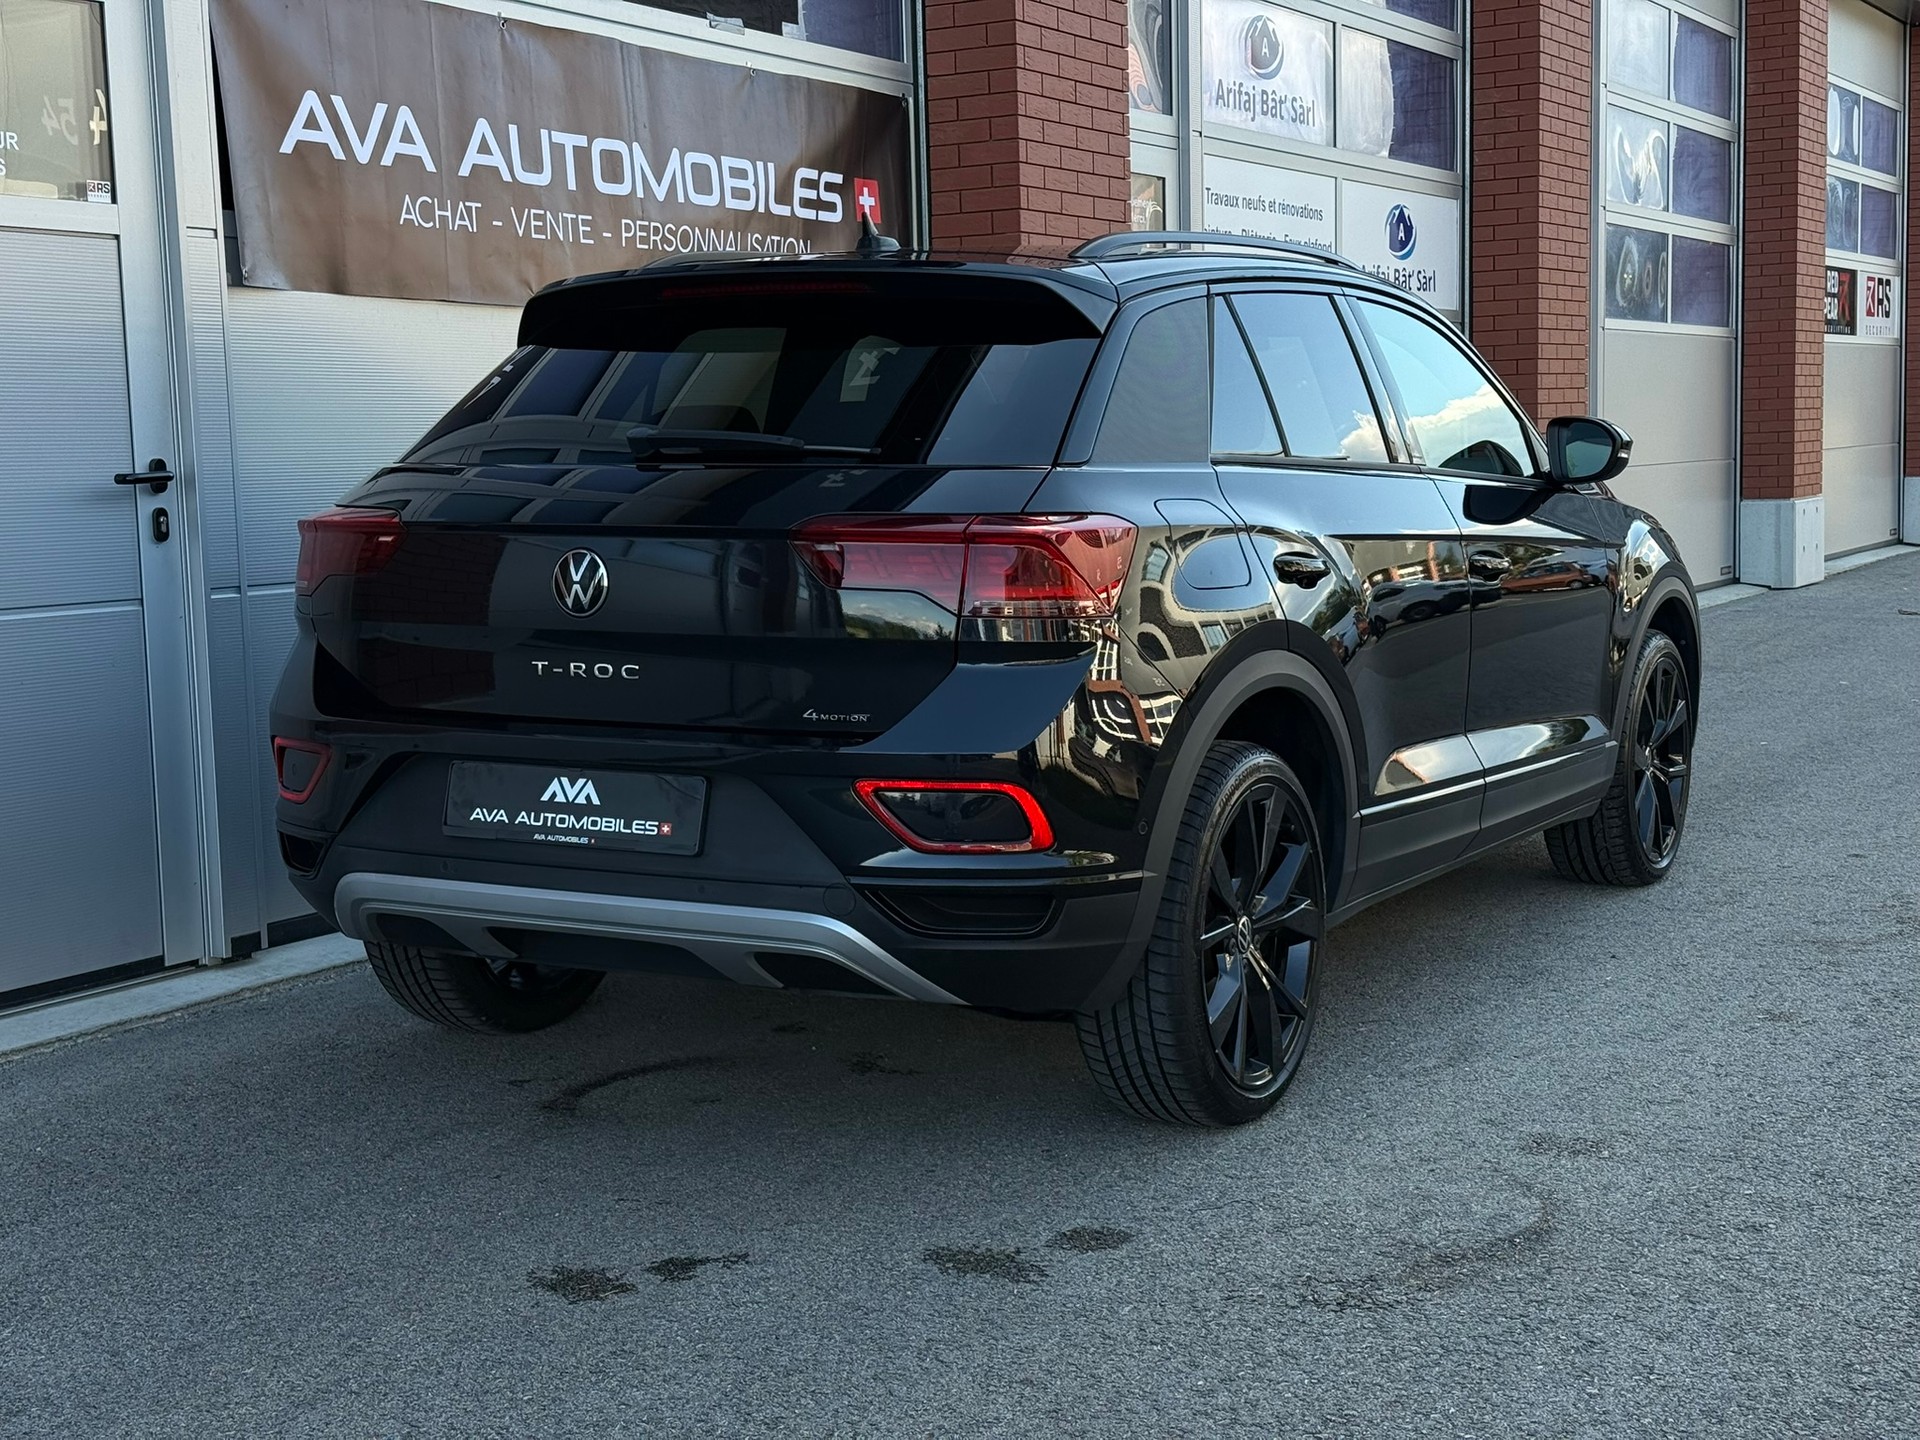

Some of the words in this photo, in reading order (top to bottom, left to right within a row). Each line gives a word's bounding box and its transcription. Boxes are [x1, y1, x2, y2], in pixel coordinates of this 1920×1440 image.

[1215, 78, 1256, 122] Arifaj
[1290, 95, 1315, 127] Sàrl
[278, 89, 437, 173] AVA
[457, 117, 844, 224] AUTOMOBILES
[96, 182, 110, 194] RS
[399, 193, 482, 233] ACHAT
[510, 206, 595, 245] VENTE
[1205, 187, 1240, 209] Travaux
[1242, 195, 1267, 213] neufs
[1268, 198, 1277, 214] et
[1278, 199, 1324, 222] rénovations
[1416, 269, 1437, 293] Sàrl
[1876, 277, 1892, 319] RS
[531, 660, 640, 680] T-ROC
[540, 776, 601, 806] AVA
[469, 807, 509, 824] AVA
[514, 810, 660, 836] AUTOMOBILES
[533, 833, 546, 841] AVA
[546, 834, 589, 844] AUTOMOBILES
